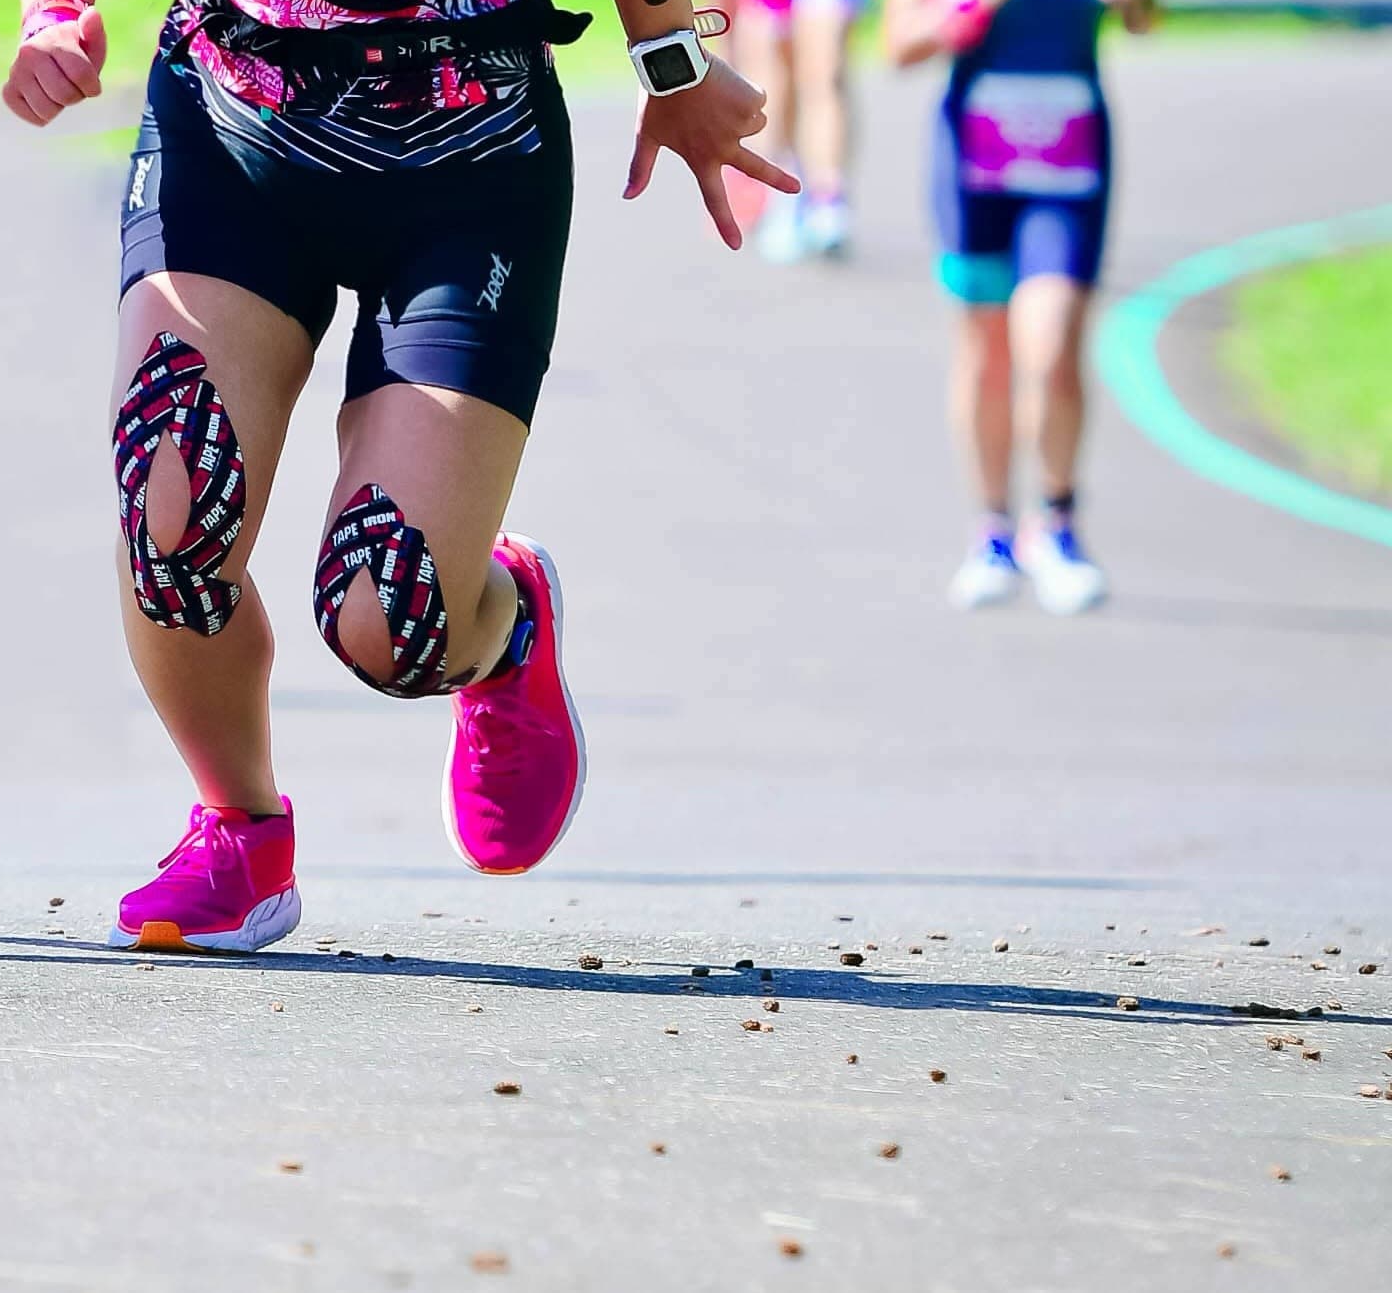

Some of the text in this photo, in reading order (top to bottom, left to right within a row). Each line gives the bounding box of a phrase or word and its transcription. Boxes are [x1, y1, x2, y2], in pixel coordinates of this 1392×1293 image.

[197, 442, 221, 472] TAPE
[200, 501, 228, 531] TAPE
[332, 523, 359, 547] TAPE
